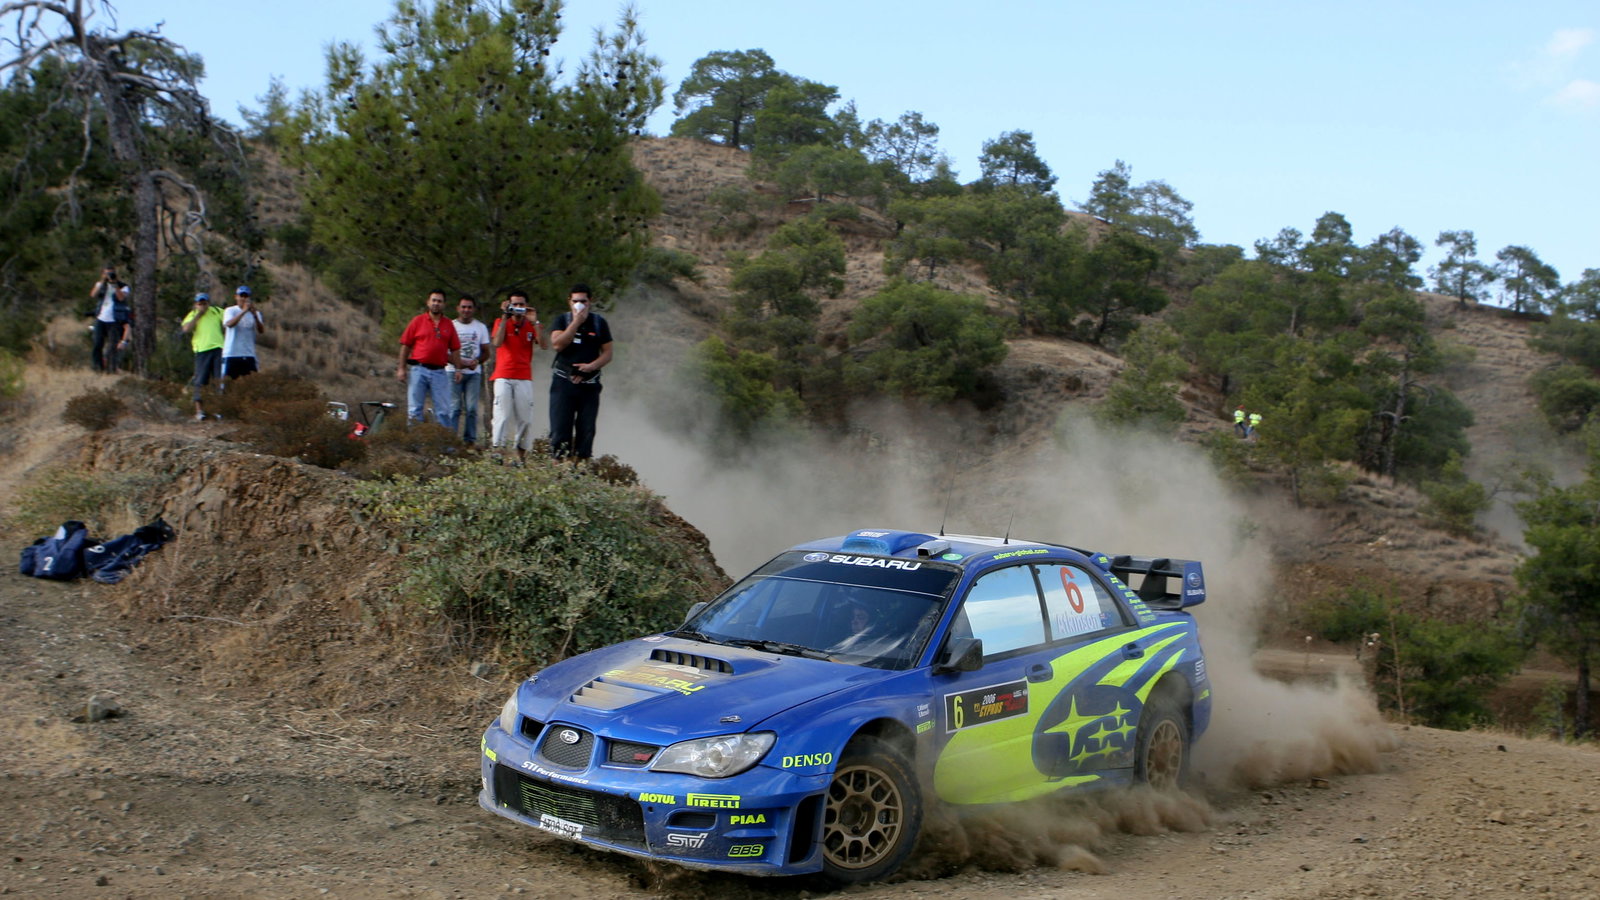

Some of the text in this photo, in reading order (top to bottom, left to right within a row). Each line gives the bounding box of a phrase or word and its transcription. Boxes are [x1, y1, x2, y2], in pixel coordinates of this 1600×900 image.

[43, 556, 54, 571] 2
[828, 554, 921, 571] SUBARU
[1060, 567, 1084, 614] 6
[1056, 611, 1099, 634] Atkinson
[982, 693, 997, 706] 2006
[953, 695, 964, 729] 6
[782, 752, 833, 768] DENSO
[536, 767, 589, 785] Performance
[639, 792, 676, 805] MOTUL
[686, 793, 741, 808] PIRELLI
[730, 813, 766, 825] PIAA
[729, 845, 763, 857] BBS
